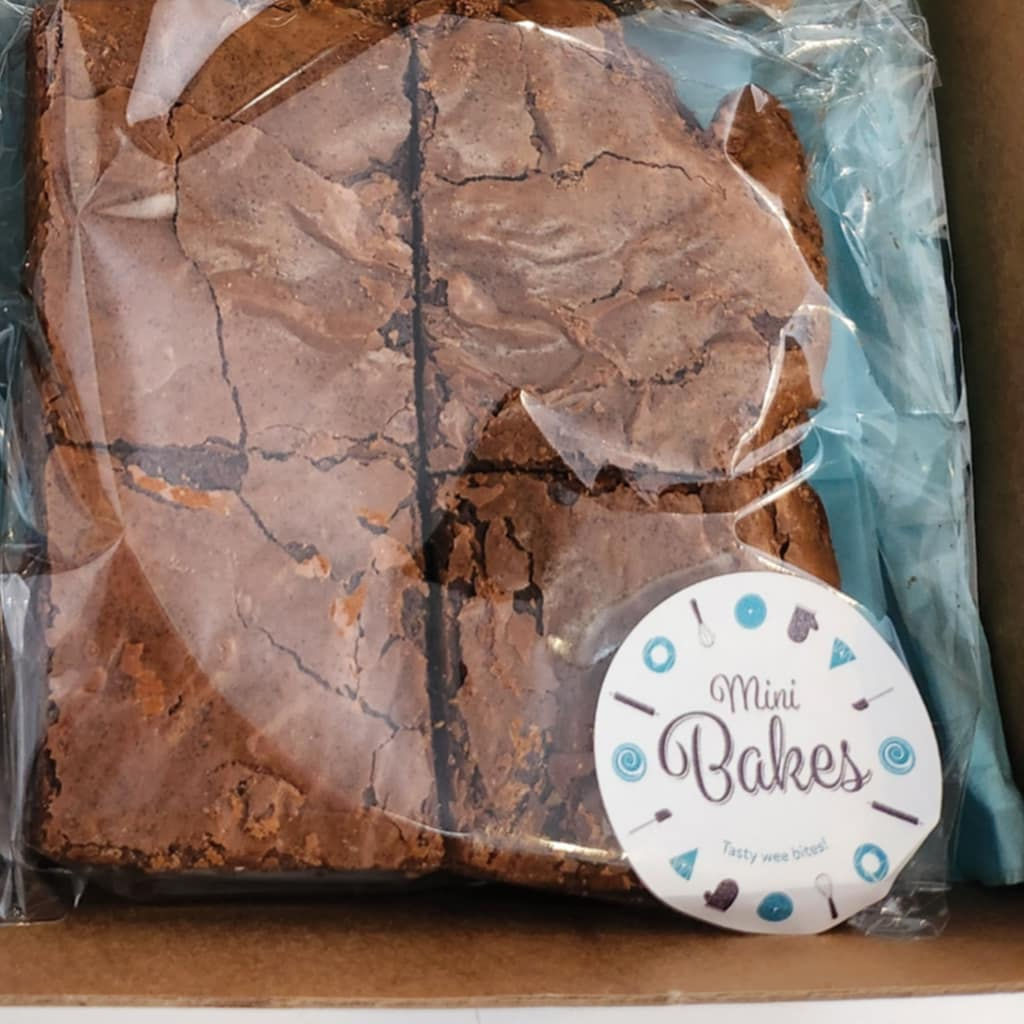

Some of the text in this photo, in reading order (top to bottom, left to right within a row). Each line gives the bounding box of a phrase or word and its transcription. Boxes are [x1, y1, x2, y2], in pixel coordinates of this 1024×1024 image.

[709, 674, 801, 713] Mini
[657, 710, 873, 805] Bakes
[722, 837, 829, 864] Tasty wee bites!
